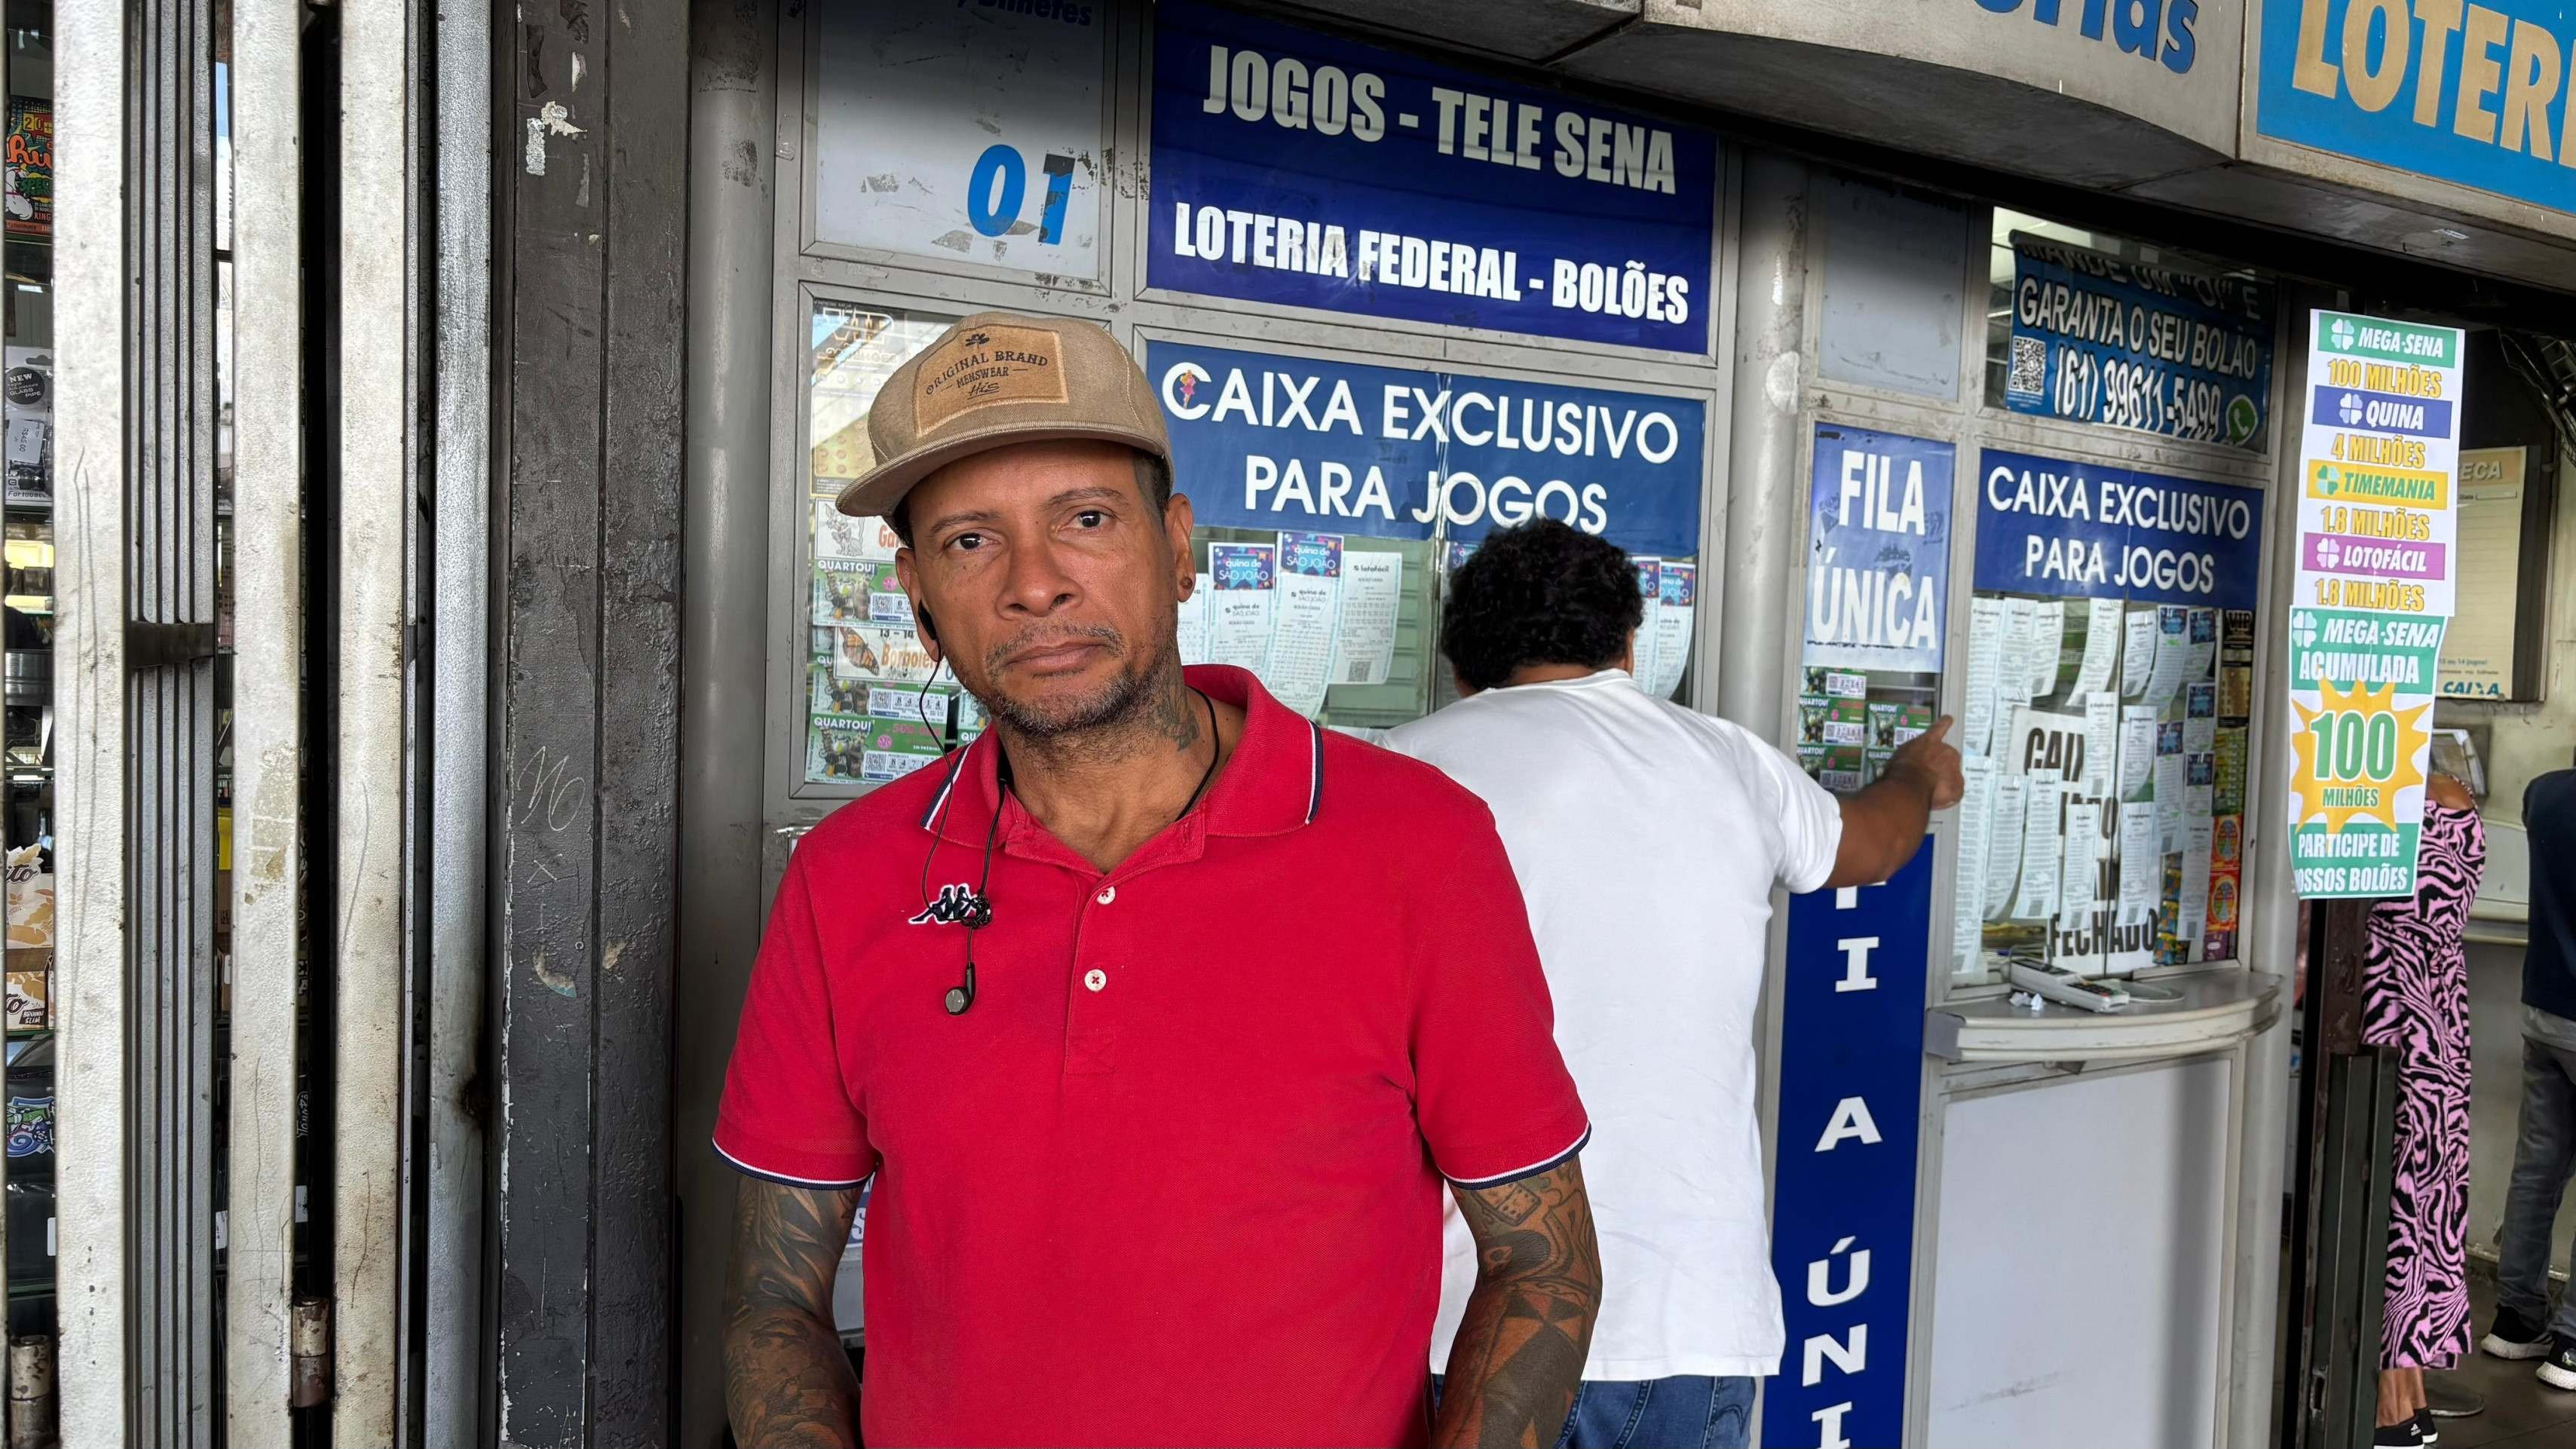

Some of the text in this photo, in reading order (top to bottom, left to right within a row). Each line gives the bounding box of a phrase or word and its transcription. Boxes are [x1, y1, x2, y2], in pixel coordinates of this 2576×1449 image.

[1204, 44, 1386, 142] JOGOS
[1432, 87, 1543, 170] TELE
[1554, 112, 1677, 195] SENA
[1175, 201, 1348, 278] LOTERIA
[1358, 229, 1521, 302] FEDERAL
[1553, 259, 1689, 325] BOLÕES
[2019, 277, 2256, 379] GARANTA O SEU BOLÃO
[10, 373, 32, 383] NEW
[927, 353, 988, 394] ORIGINAL
[995, 351, 1048, 366] BRAND
[956, 366, 1009, 388] MENSWEAR
[2328, 359, 2443, 398] 100 MILHÕES
[2055, 346, 2221, 441] (61) 99611-5499
[1161, 362, 1679, 464] CAIXA EXCLUSIVO
[2365, 400, 2424, 430] QUINA
[2332, 433, 2425, 469] 4 MILHÕES
[2343, 472, 2435, 501] TIMEMANIA
[2460, 461, 2503, 482] ECA
[1245, 455, 1608, 535] PARA JOGOS
[1839, 450, 1925, 536] FILA
[1986, 466, 2250, 539] CAIXA EXCLUSIVO
[2320, 506, 2430, 541] 1.8 MILHÕES
[2026, 535, 2215, 594] PARA JOGOS
[2343, 544, 2427, 572] LOTOFÁCIL
[1812, 547, 1936, 651] ÚNICA
[2315, 578, 2425, 611] 1.8 MILHÕES
[2299, 651, 2419, 684] ACUMULADA
[2309, 710, 2398, 781] 100
[2323, 786, 2378, 807] MILHÕES
[2299, 833, 2400, 858] PARTICIPE DE
[2349, 862, 2408, 892] BOLÕES
